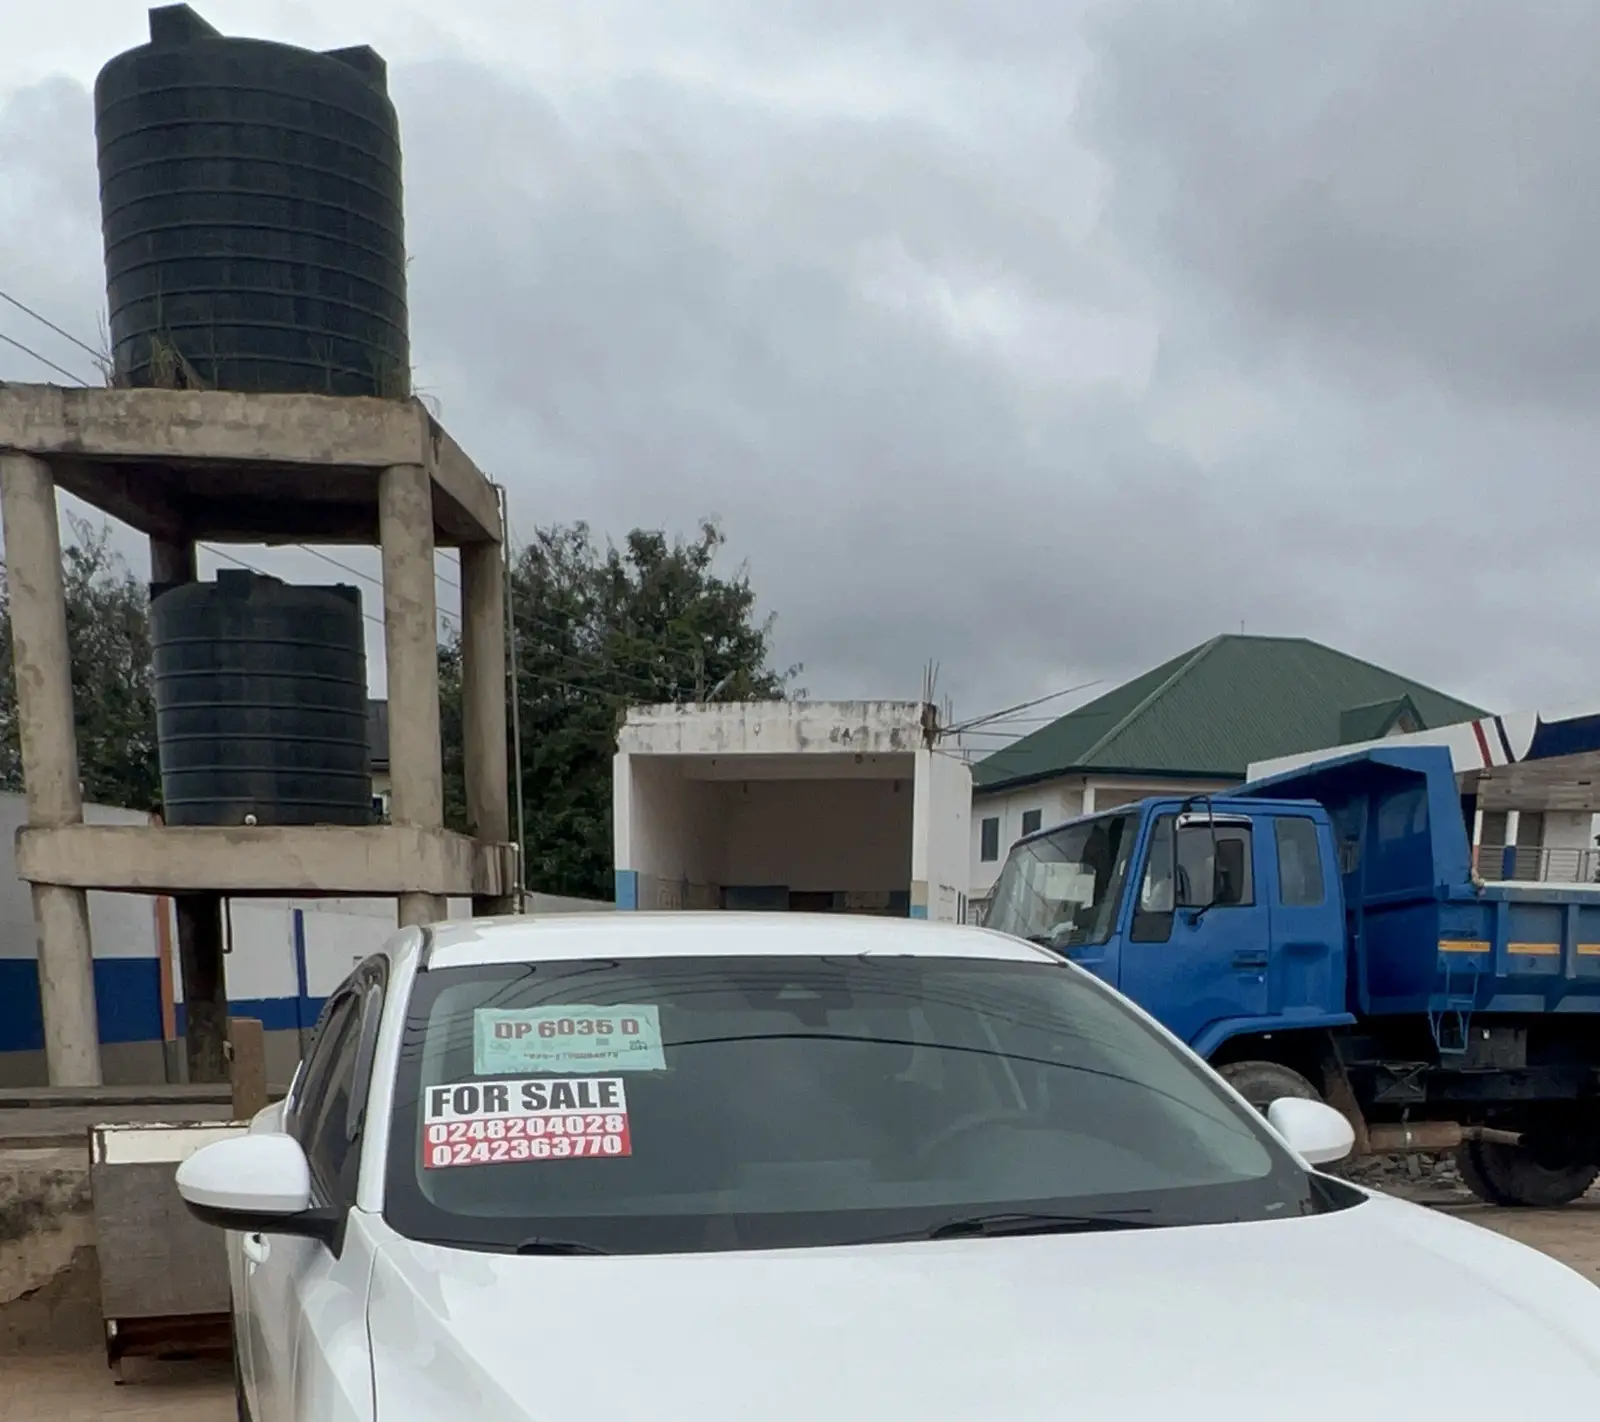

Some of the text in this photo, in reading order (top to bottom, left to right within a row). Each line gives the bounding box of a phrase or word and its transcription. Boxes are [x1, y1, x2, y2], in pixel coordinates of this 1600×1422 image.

[538, 1019, 614, 1038] 6035
[431, 1080, 620, 1117] FOR SALE
[428, 1114, 624, 1145] 0248204028
[431, 1135, 622, 1166] 0242363770
